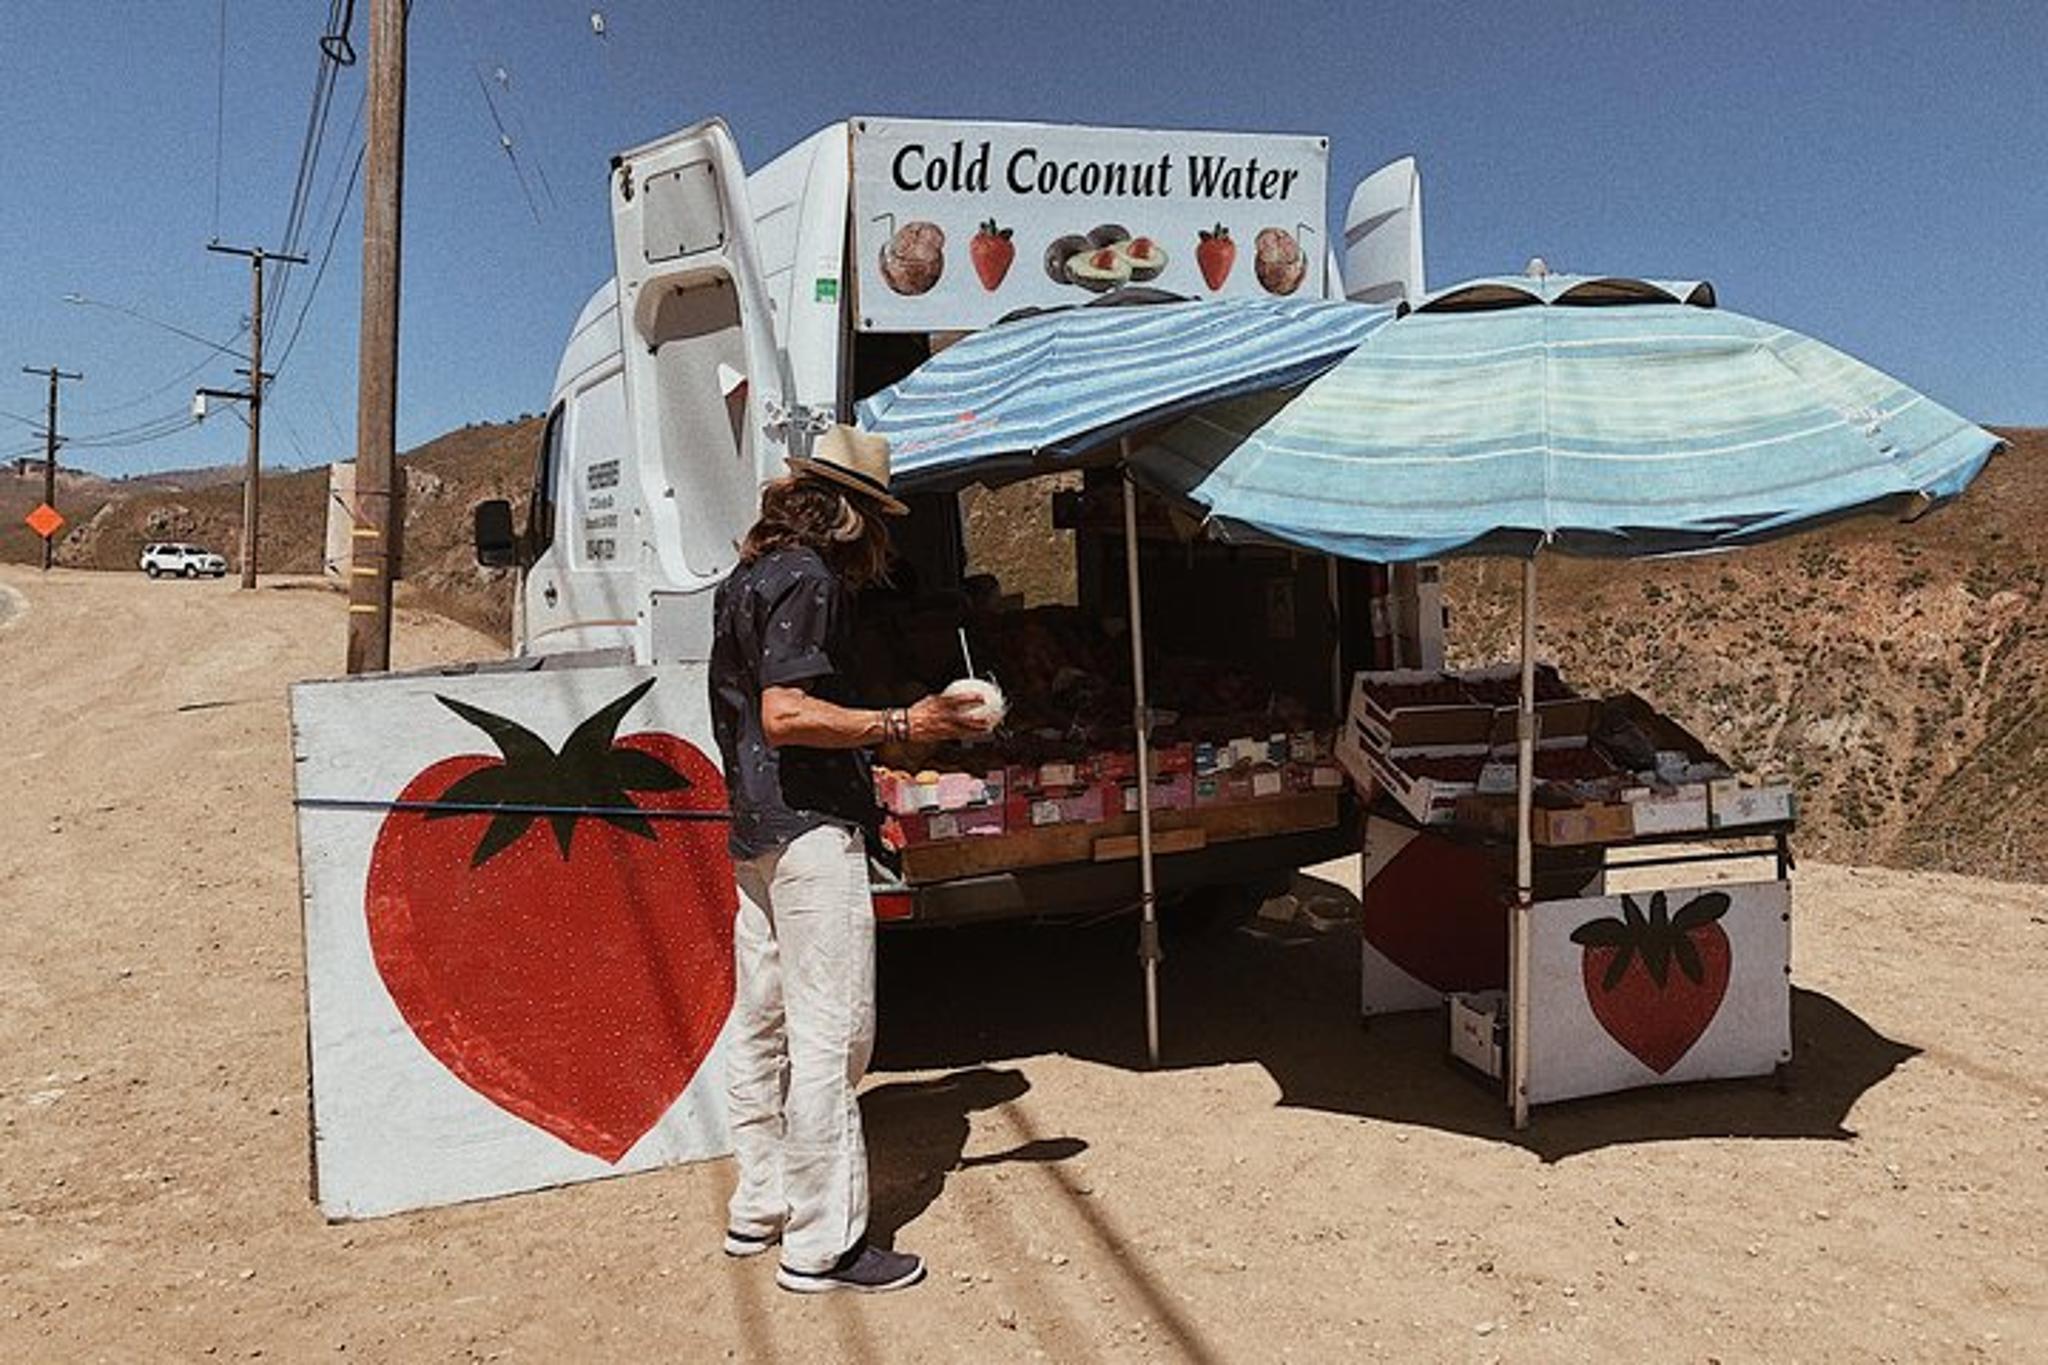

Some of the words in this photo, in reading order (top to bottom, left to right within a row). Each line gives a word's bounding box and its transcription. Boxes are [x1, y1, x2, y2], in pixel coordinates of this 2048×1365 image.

[892, 140, 991, 193] Cold
[1006, 147, 1173, 197] Coconut
[1187, 155, 1299, 200] Water
